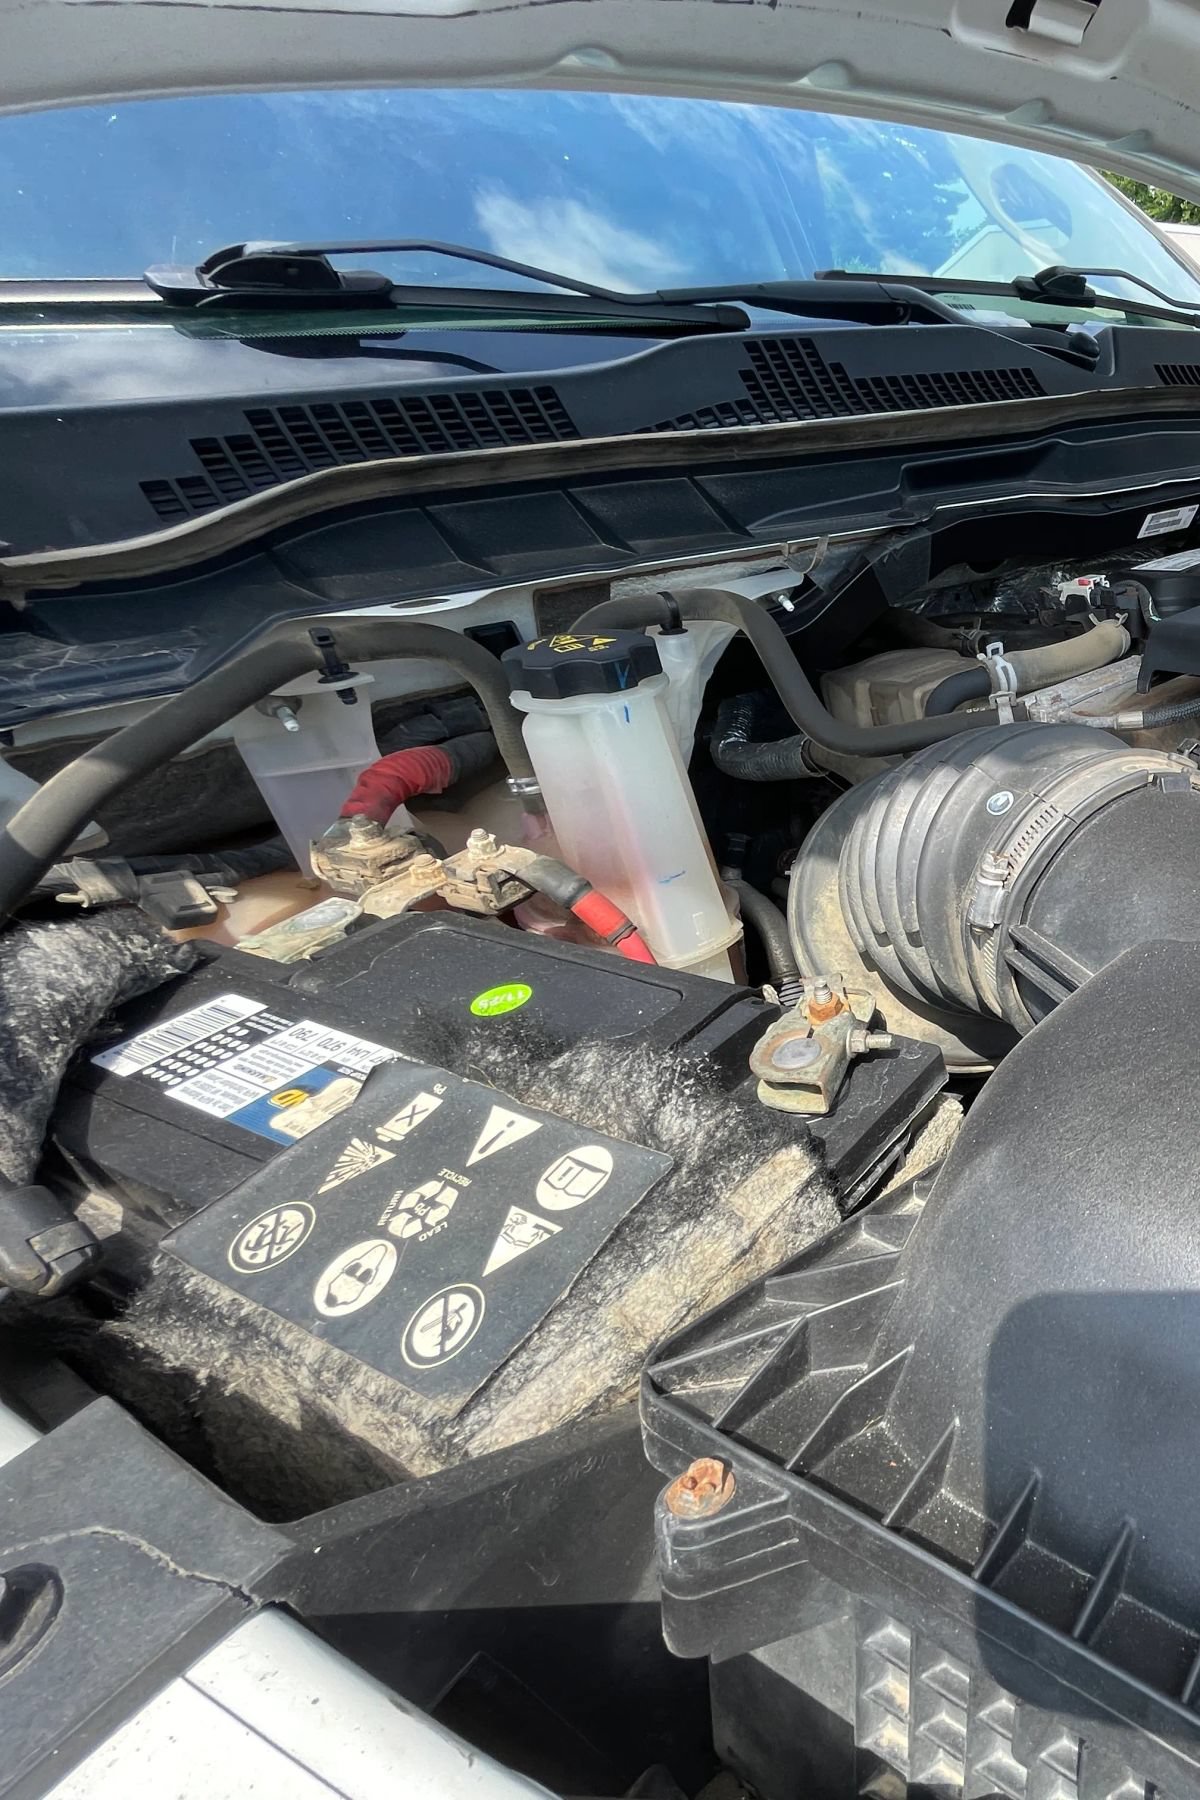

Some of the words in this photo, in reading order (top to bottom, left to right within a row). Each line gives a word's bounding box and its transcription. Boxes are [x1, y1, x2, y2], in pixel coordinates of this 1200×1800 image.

[288, 1027, 319, 1041] 790
[316, 1037, 348, 1052] 970
[433, 1083, 447, 1095] Pb
[437, 1168, 473, 1187] RECYCLE
[377, 1190, 404, 1226] RETURN
[414, 1202, 432, 1217] Pb
[418, 1221, 448, 1242] LEAD
